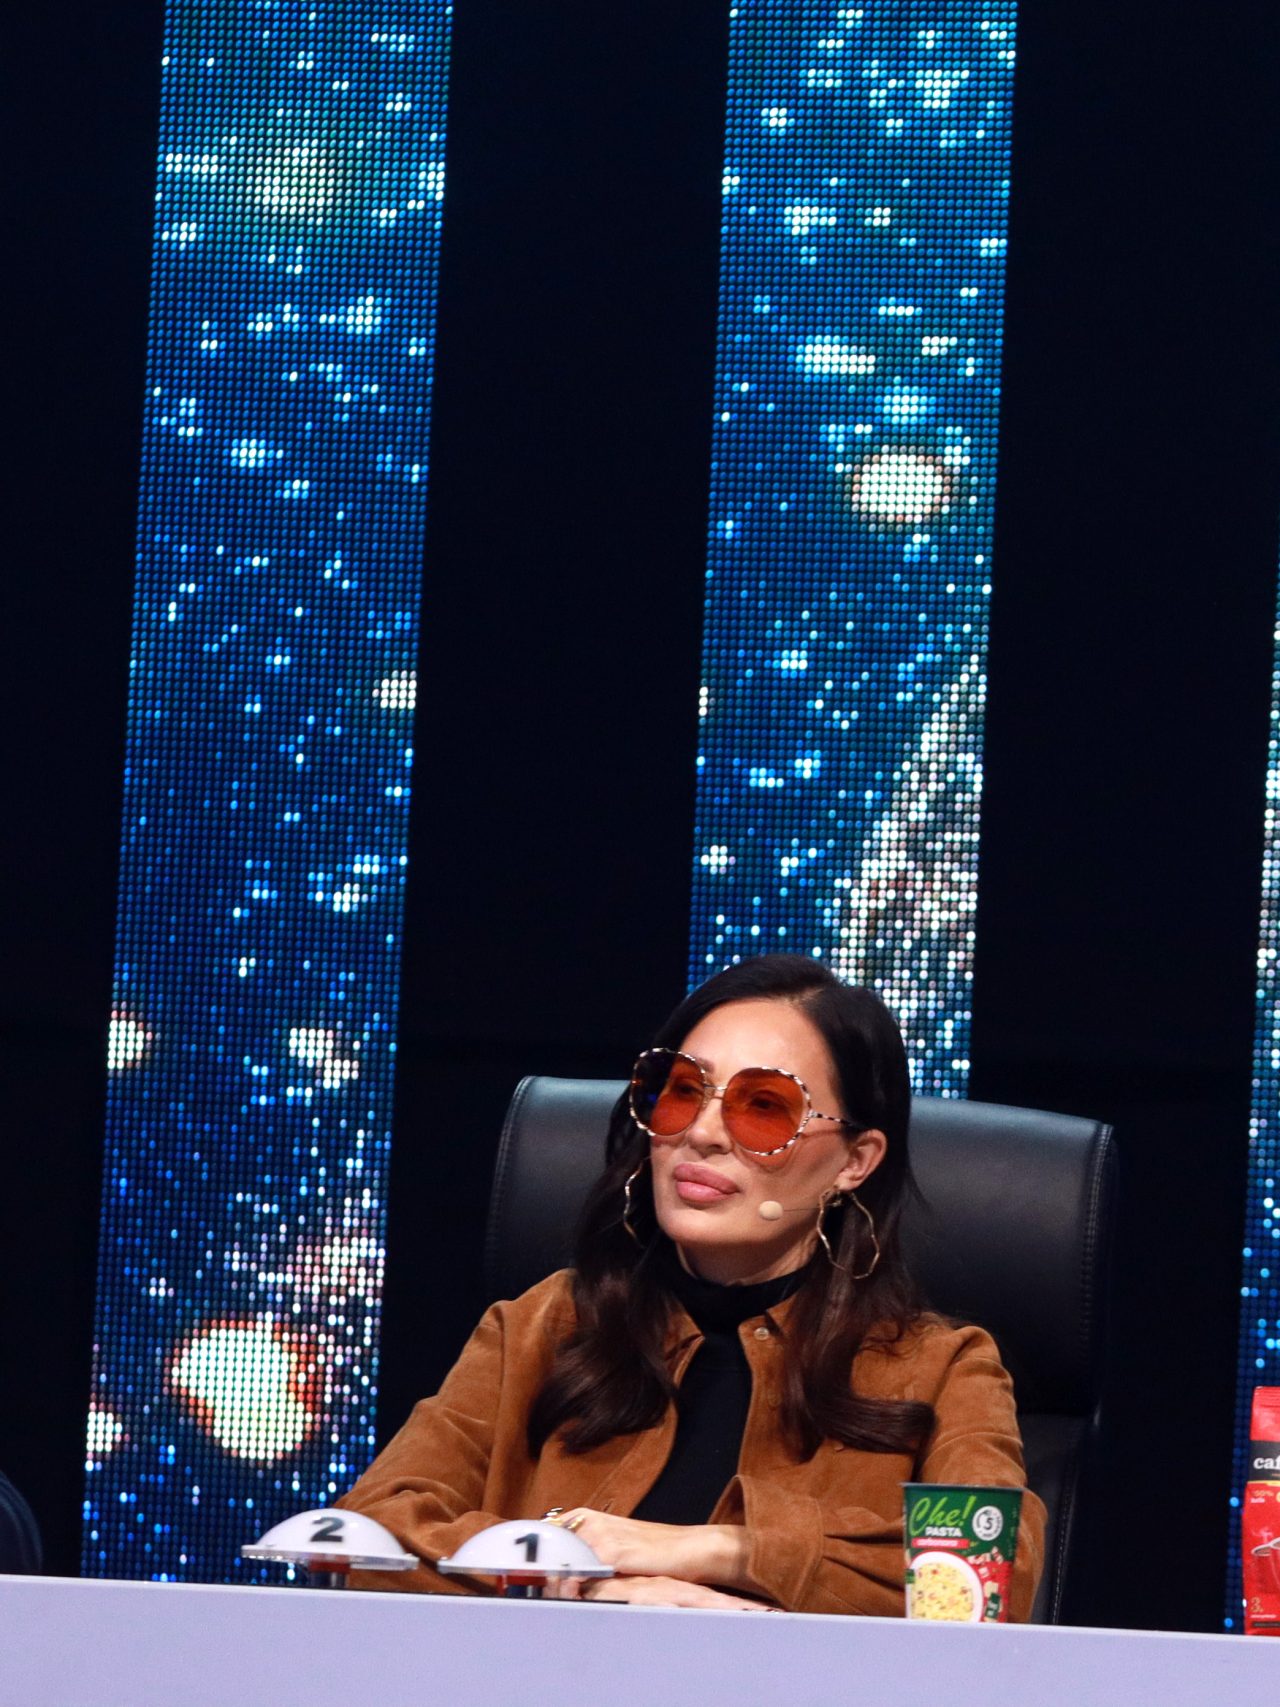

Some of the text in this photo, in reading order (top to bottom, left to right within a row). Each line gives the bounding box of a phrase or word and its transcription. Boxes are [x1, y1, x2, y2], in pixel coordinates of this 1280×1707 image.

[909, 1495, 977, 1536] Che!
[983, 1517, 993, 1530] 5
[310, 1516, 346, 1543] 2
[925, 1526, 963, 1537] PASTA
[514, 1533, 540, 1563] 1
